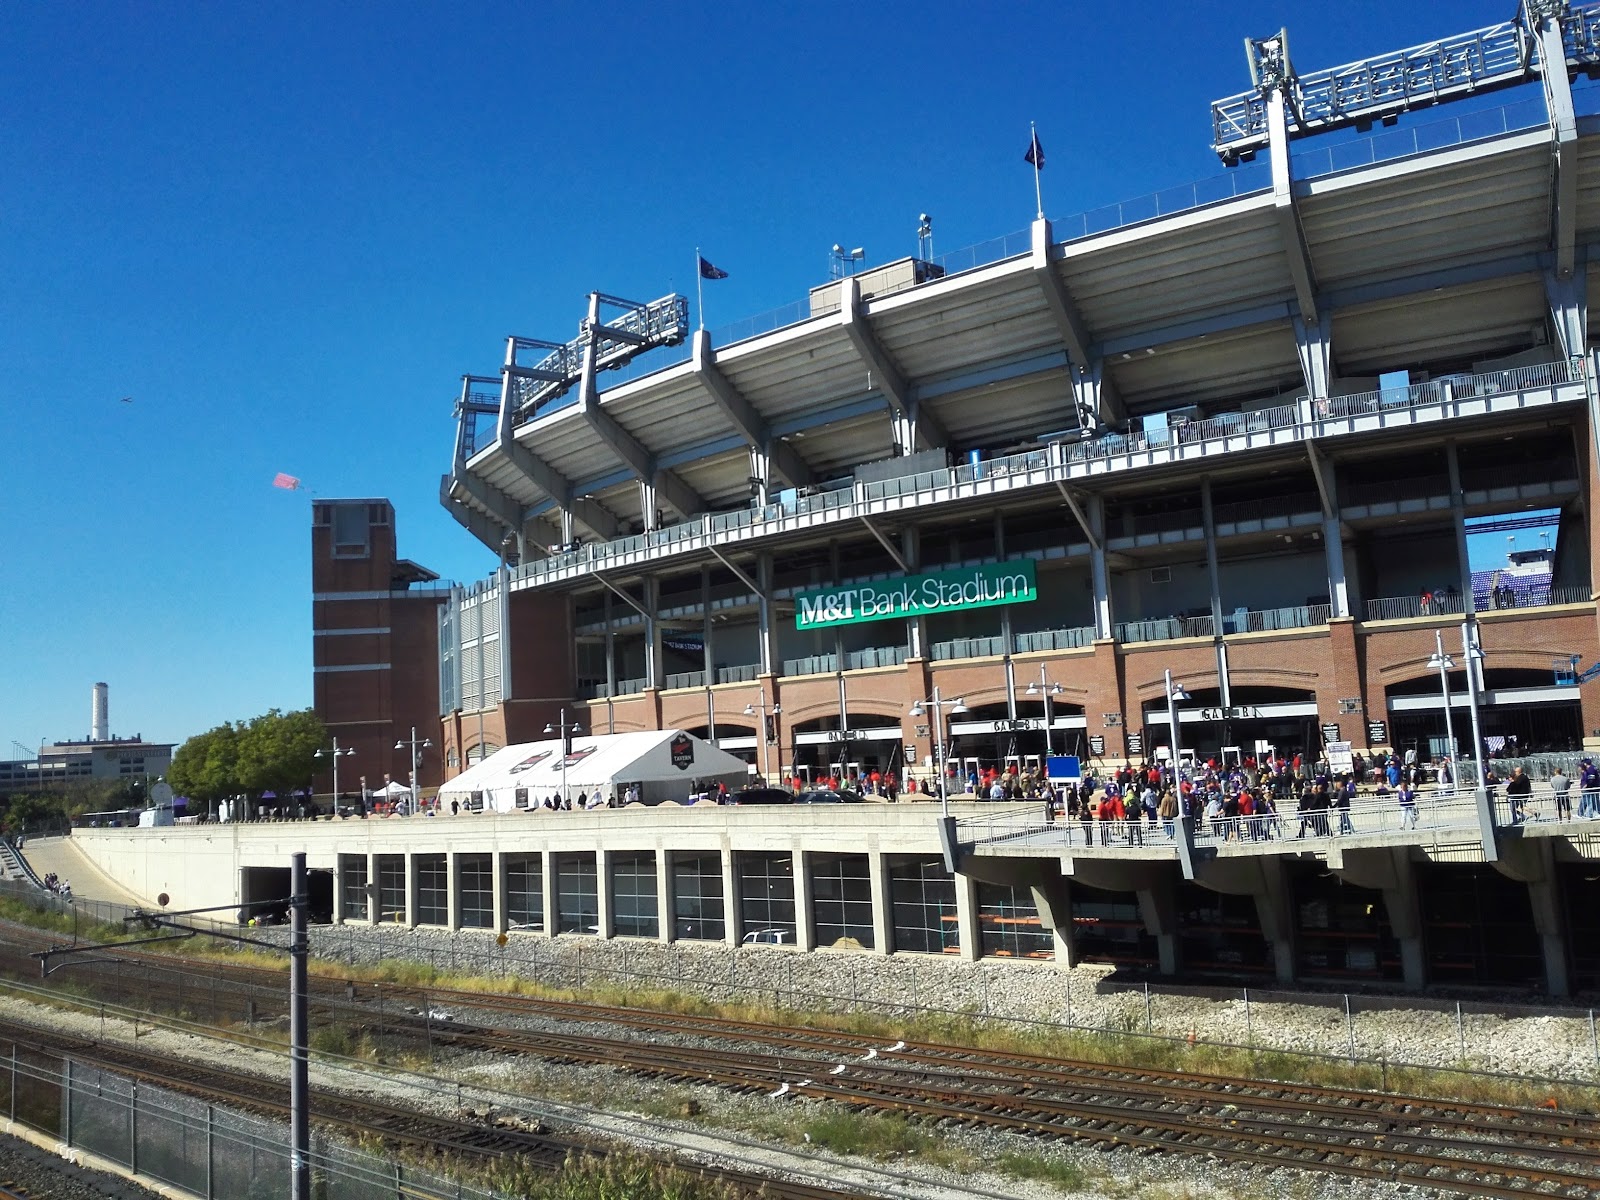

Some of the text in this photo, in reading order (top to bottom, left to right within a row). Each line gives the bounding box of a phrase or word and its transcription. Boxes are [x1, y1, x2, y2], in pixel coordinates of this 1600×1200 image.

[800, 572, 1028, 625] M&T Bank Stadium
